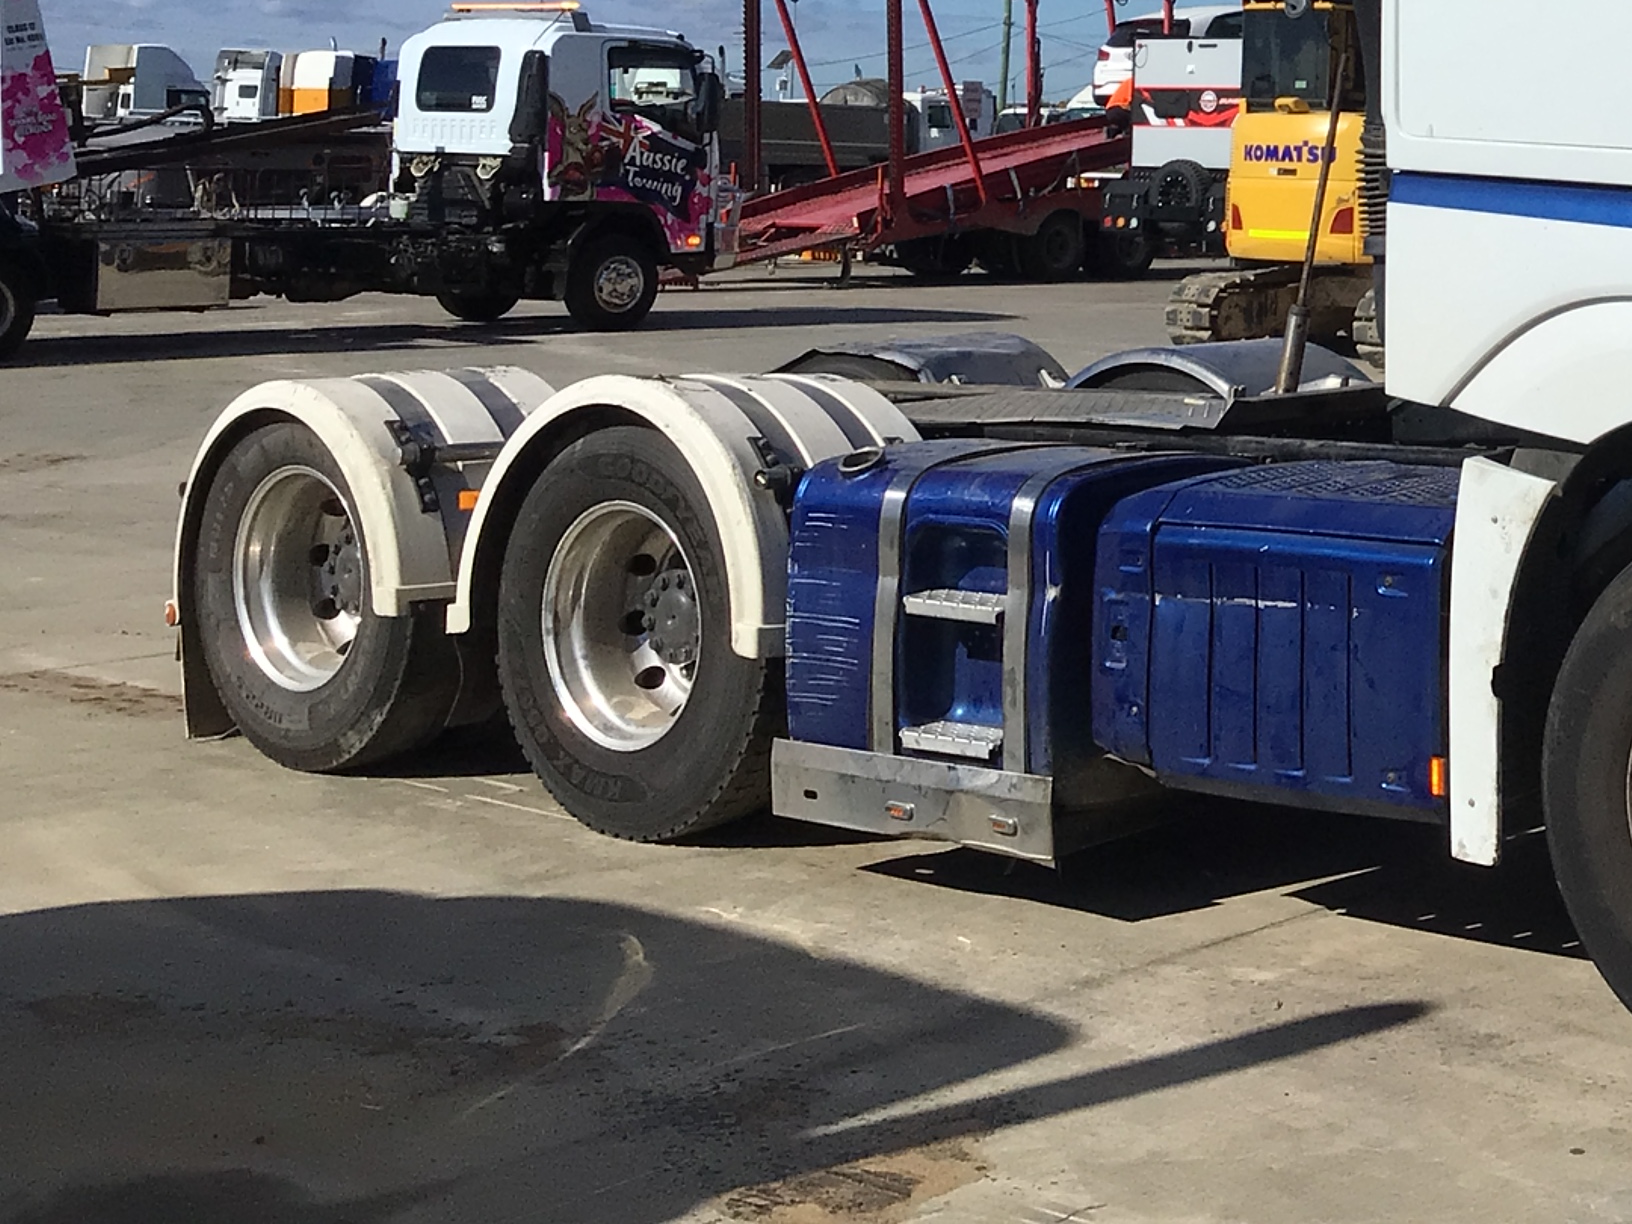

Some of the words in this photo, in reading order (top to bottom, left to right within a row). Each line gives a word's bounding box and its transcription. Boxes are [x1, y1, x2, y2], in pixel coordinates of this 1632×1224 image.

[624, 136, 687, 175] Aussie
[1244, 140, 1337, 163] KOMATSU
[625, 165, 682, 206] Towing
